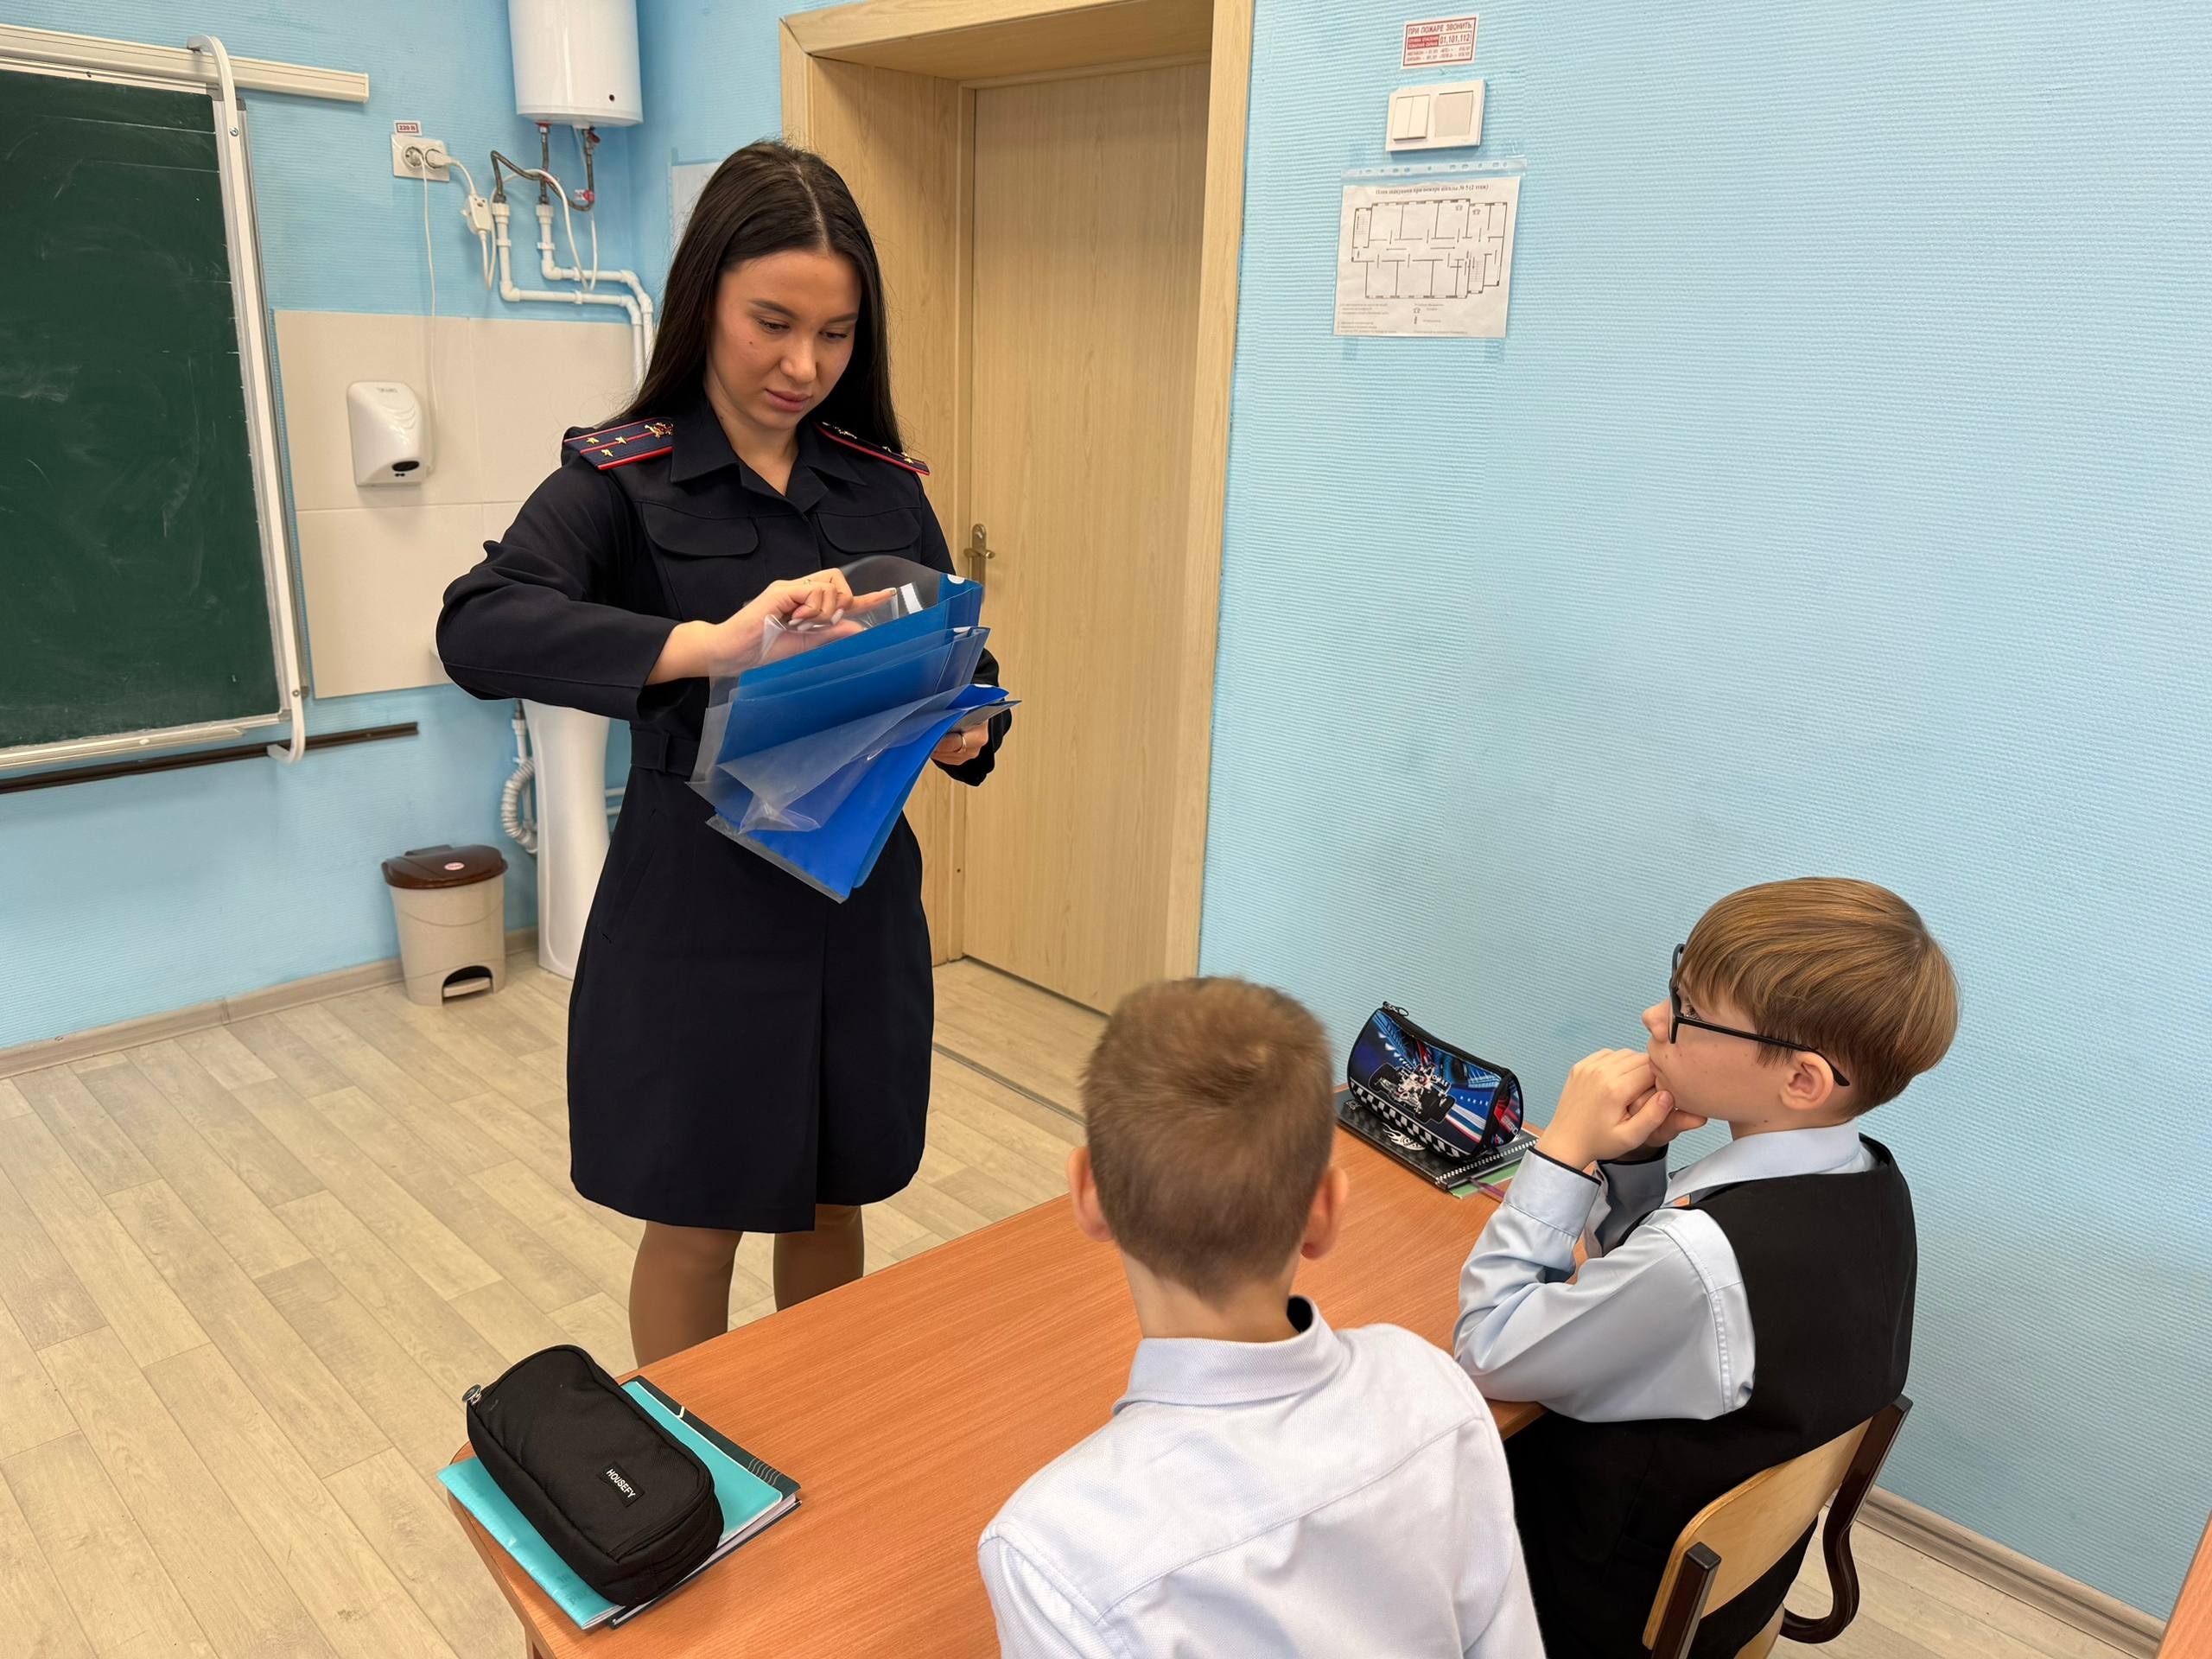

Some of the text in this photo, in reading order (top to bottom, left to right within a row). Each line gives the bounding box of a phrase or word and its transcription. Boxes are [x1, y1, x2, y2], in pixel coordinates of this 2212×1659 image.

[1421, 25, 1444, 34] ПОЖАРЕ
[1440, 34, 1470, 44] 01.101.112
[606, 1468, 636, 1498] HOUSEFY
